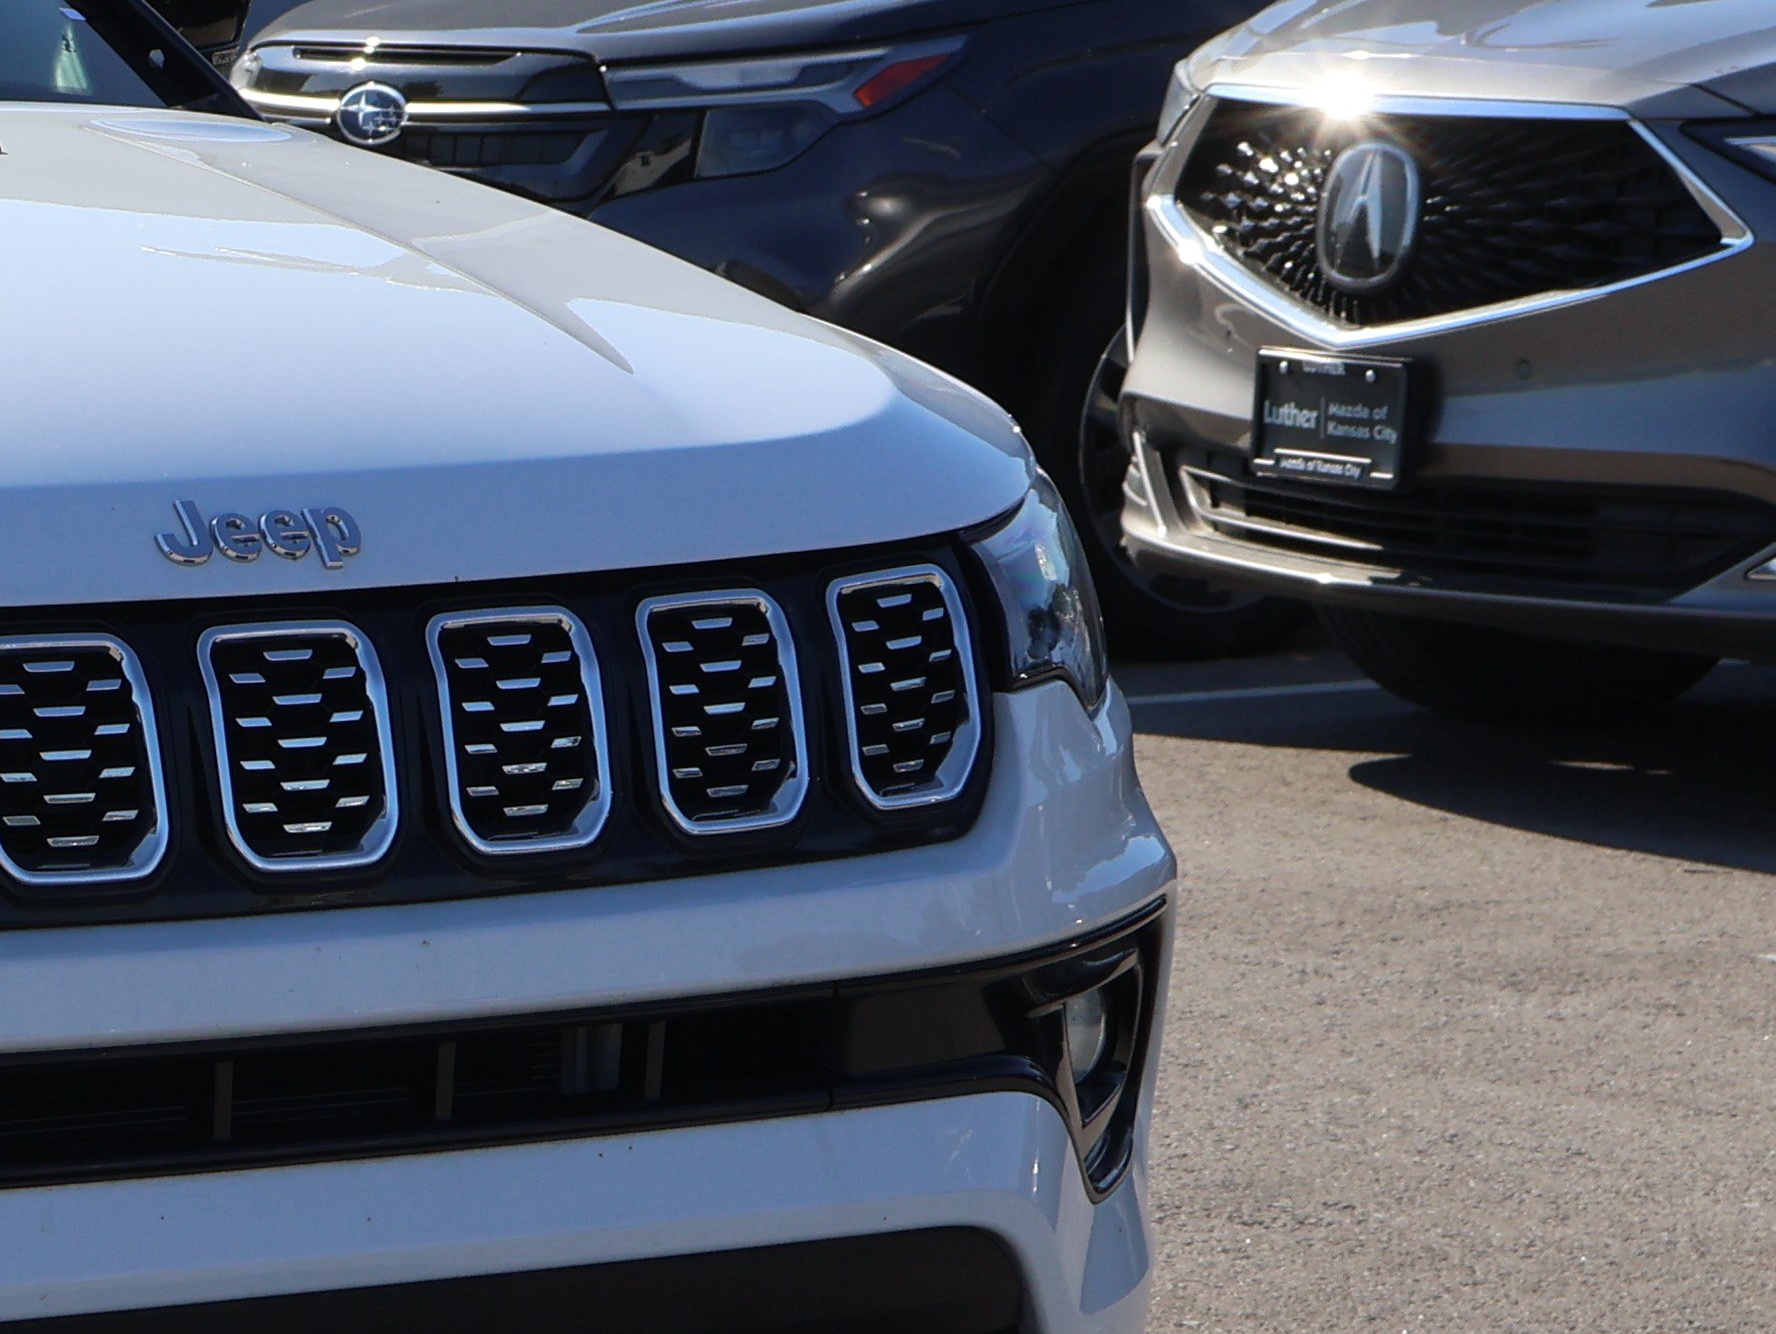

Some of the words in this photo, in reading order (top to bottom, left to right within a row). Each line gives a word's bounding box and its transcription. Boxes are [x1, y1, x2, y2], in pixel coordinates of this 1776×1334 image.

[1263, 399, 1319, 430] Luther
[1328, 402, 1371, 420] Mazda
[1372, 405, 1389, 420] of
[1327, 420, 1371, 440] Kansas
[1373, 424, 1399, 445] City
[153, 499, 362, 570] Jeep
